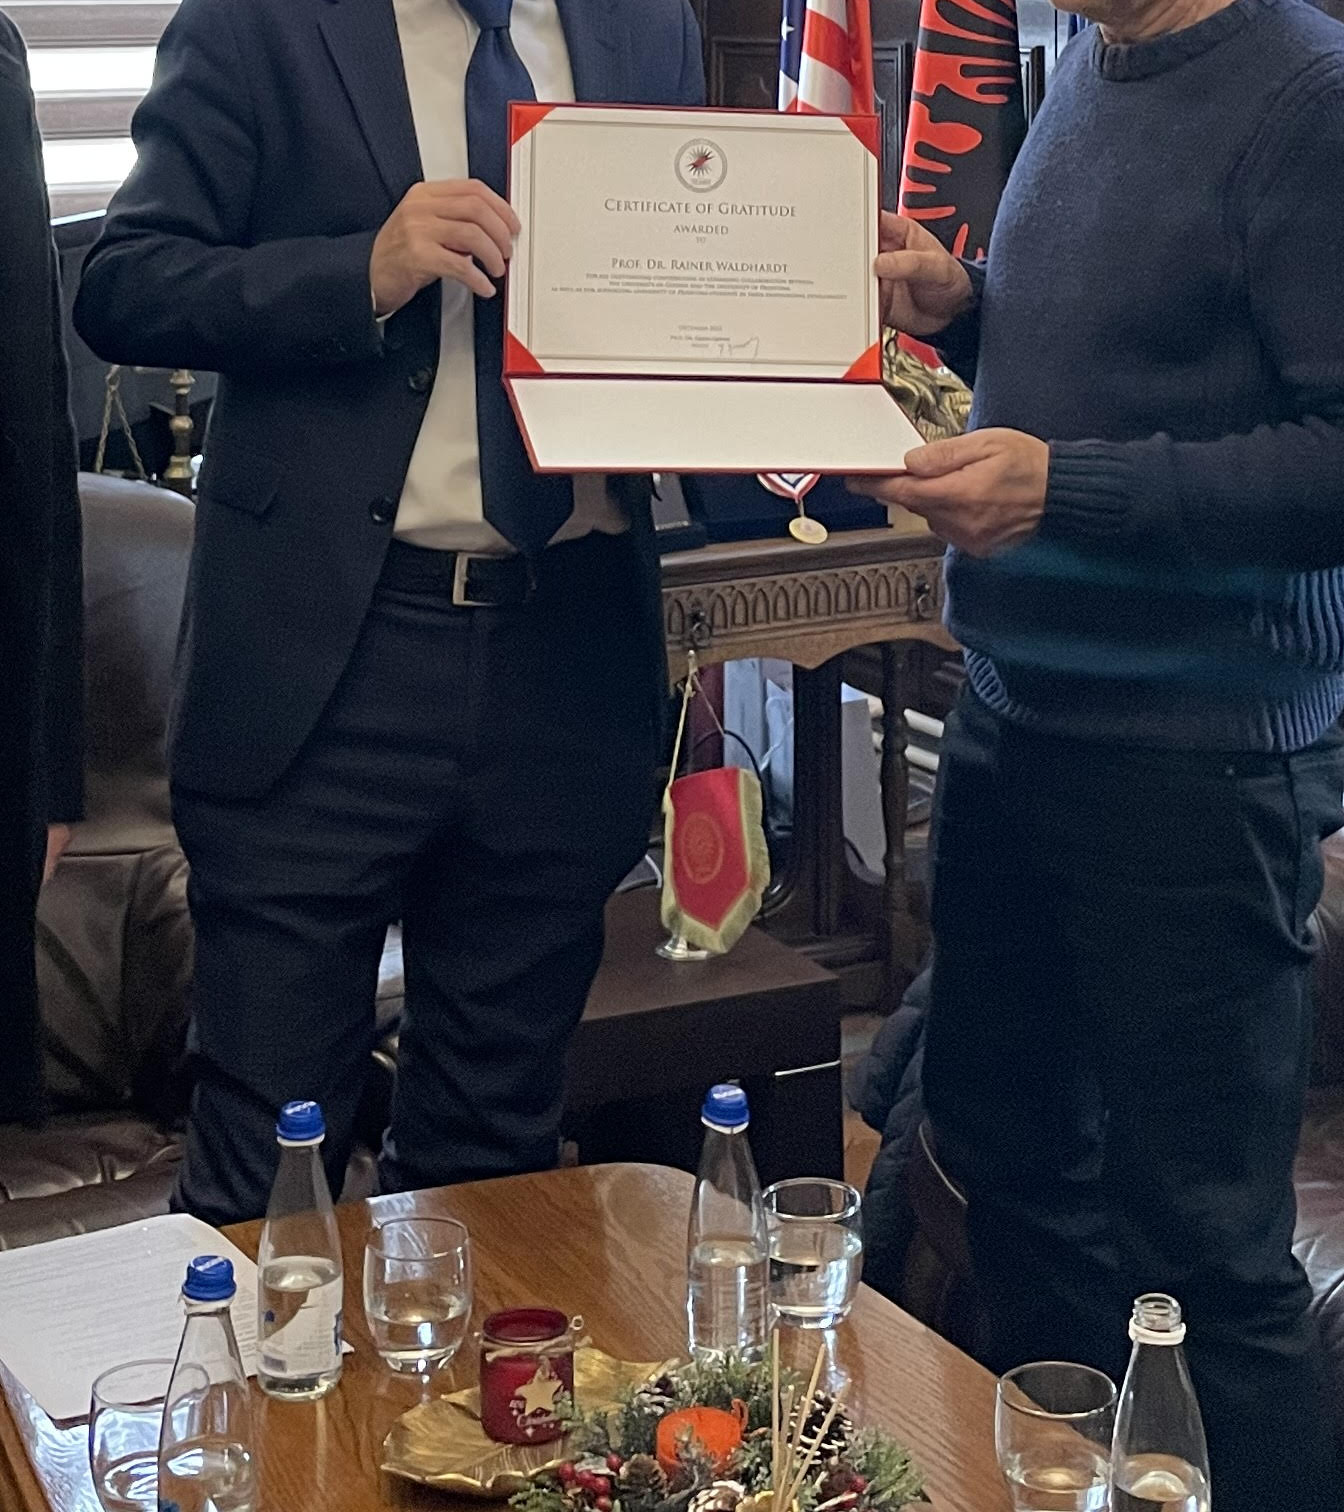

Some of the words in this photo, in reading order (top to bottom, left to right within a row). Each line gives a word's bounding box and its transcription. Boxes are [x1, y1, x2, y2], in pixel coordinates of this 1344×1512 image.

[604, 199, 691, 214] CERTIFICATE
[695, 202, 714, 215] OF
[718, 202, 797, 217] GRATITUDE
[673, 224, 729, 235] AWARDED
[671, 259, 714, 272] RAINER
[716, 261, 788, 273] WALDHARDT
